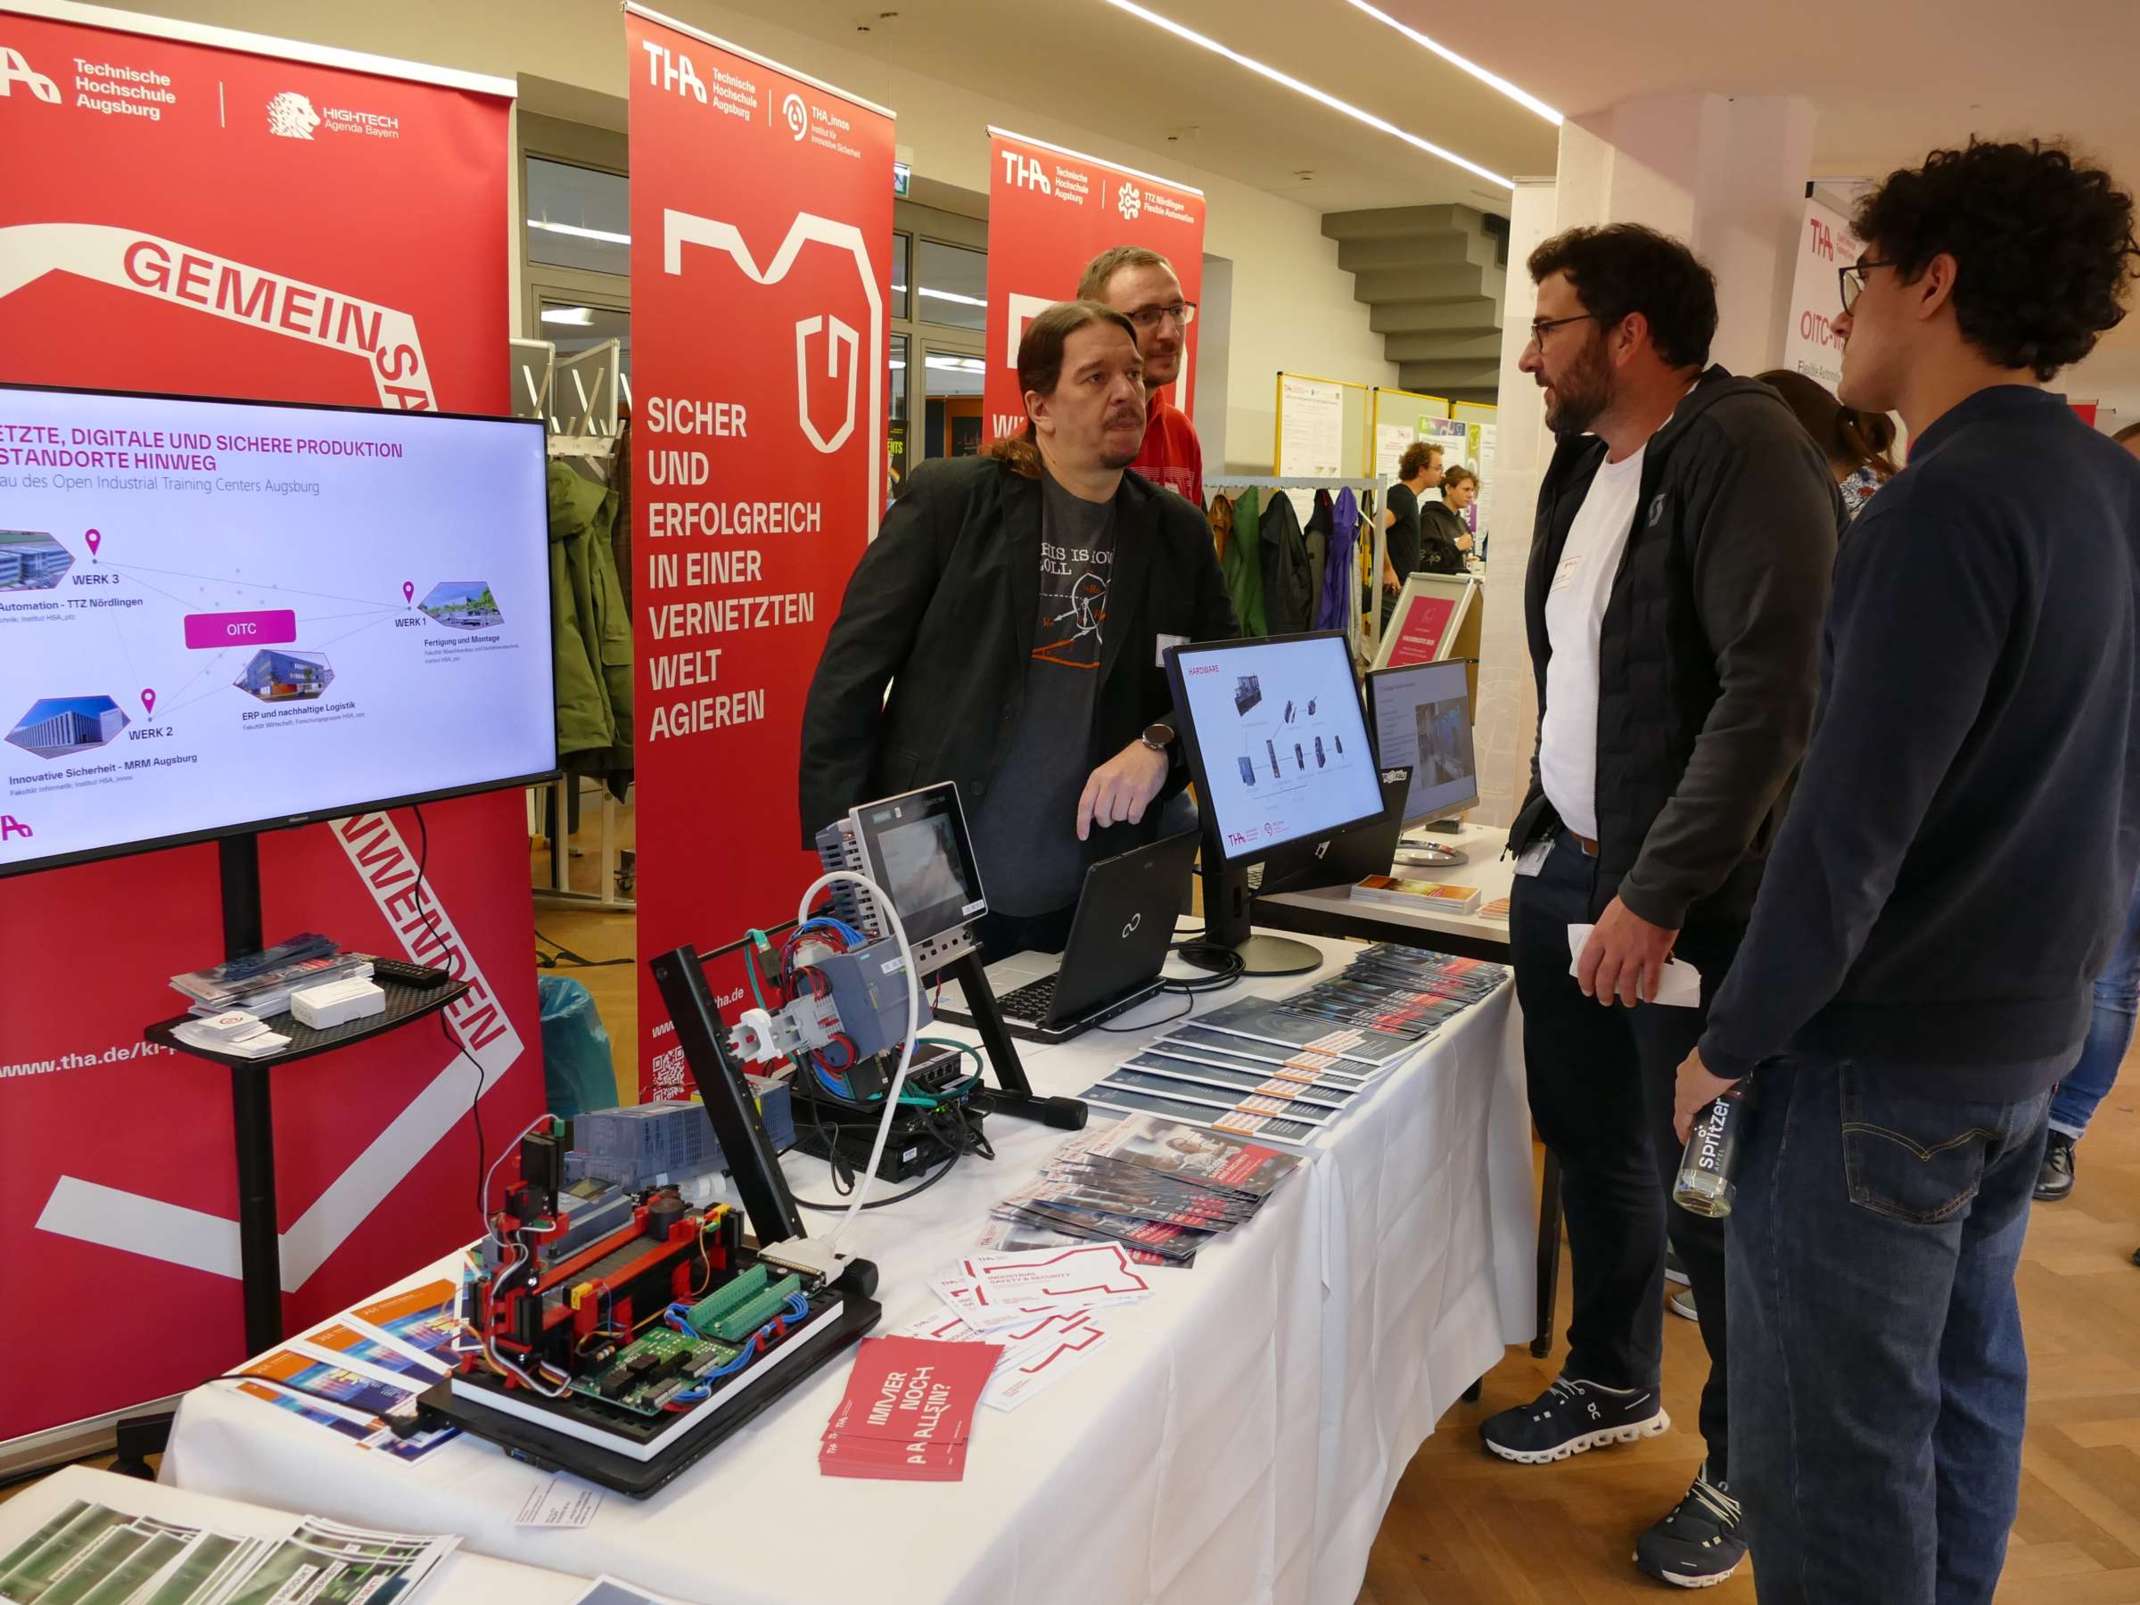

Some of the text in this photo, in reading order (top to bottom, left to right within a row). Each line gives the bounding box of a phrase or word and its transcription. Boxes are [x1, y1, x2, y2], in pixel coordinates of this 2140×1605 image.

[73, 57, 171, 86] Technische
[642, 40, 708, 104] THA
[712, 66, 756, 93] Technische
[75, 76, 176, 104] Hochschule
[713, 81, 758, 108] Hochschule
[76, 93, 161, 121] Augsburg
[323, 107, 399, 129] HIGHTECH
[713, 96, 750, 121] Augsburg
[325, 119, 399, 139] Agenda Bayern
[1001, 150, 1051, 195] THA
[1055, 166, 1088, 183] Technische
[1055, 178, 1089, 194] Hochschule
[1055, 188, 1084, 205] Augsburg
[647, 396, 747, 438] SICHER
[71, 427, 164, 449] DIGITALE
[169, 433, 212, 451] UND
[216, 435, 293, 454] SICHERE
[297, 439, 403, 459] PRODUKTION
[0, 447, 217, 472] STANDORTE HINWEG
[648, 449, 709, 486] UND
[22, 474, 48, 489] des
[52, 474, 93, 494] Open
[97, 475, 159, 491] Industrial
[162, 476, 212, 494] Training
[215, 478, 261, 493] Centers
[264, 479, 321, 496] Augsburg
[649, 501, 821, 538] ERFOLGREICH
[1071, 548, 1090, 562] IS
[72, 574, 120, 585] WERK 3
[649, 549, 762, 589] IN EINER
[67, 599, 88, 609] TTZ
[89, 597, 144, 608] Nördlingen
[648, 592, 815, 640] VERNETZTEN
[226, 622, 257, 636] OITC
[395, 617, 427, 628] WERK 1
[424, 634, 500, 648] Fertigung und Montage
[649, 648, 722, 691] WELT
[242, 701, 356, 721] ERP und nachhaltige Logistik
[649, 688, 765, 742] AGIEREN
[129, 726, 174, 742] WERK 2
[9, 769, 64, 785] Innovative
[65, 763, 116, 778] Sicherheit
[124, 758, 152, 771] MRM
[153, 753, 198, 767] Augsburg
[1699, 1097, 1730, 1169] spritzer
[990, 1276, 1022, 1284] SAFETY
[1030, 1272, 1071, 1280] SECURITY
[899, 1366, 935, 1410] NOCH
